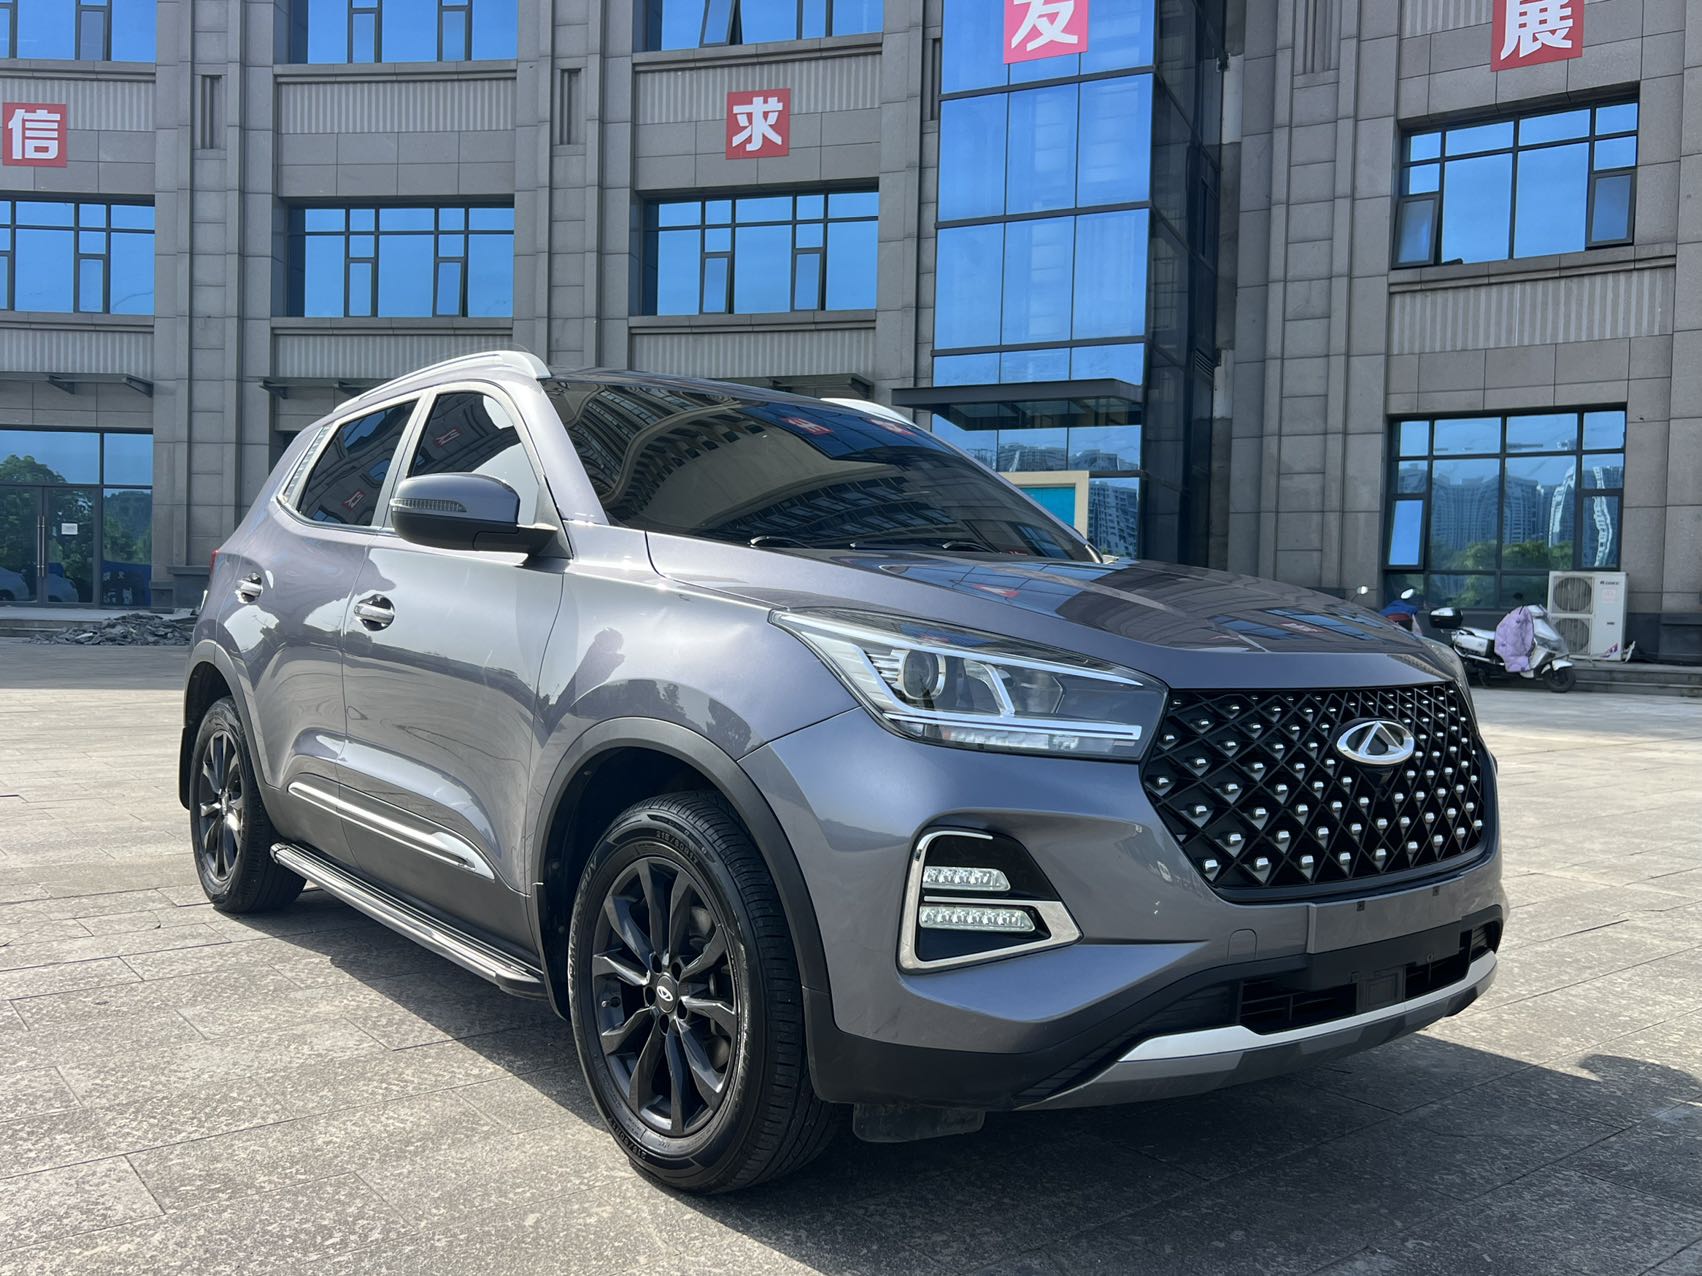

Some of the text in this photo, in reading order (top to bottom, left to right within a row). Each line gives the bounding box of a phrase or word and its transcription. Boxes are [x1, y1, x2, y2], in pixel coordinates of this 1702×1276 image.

[1500, 0, 1574, 60] 展
[8, 109, 61, 160] 信
[732, 96, 783, 152] 求
